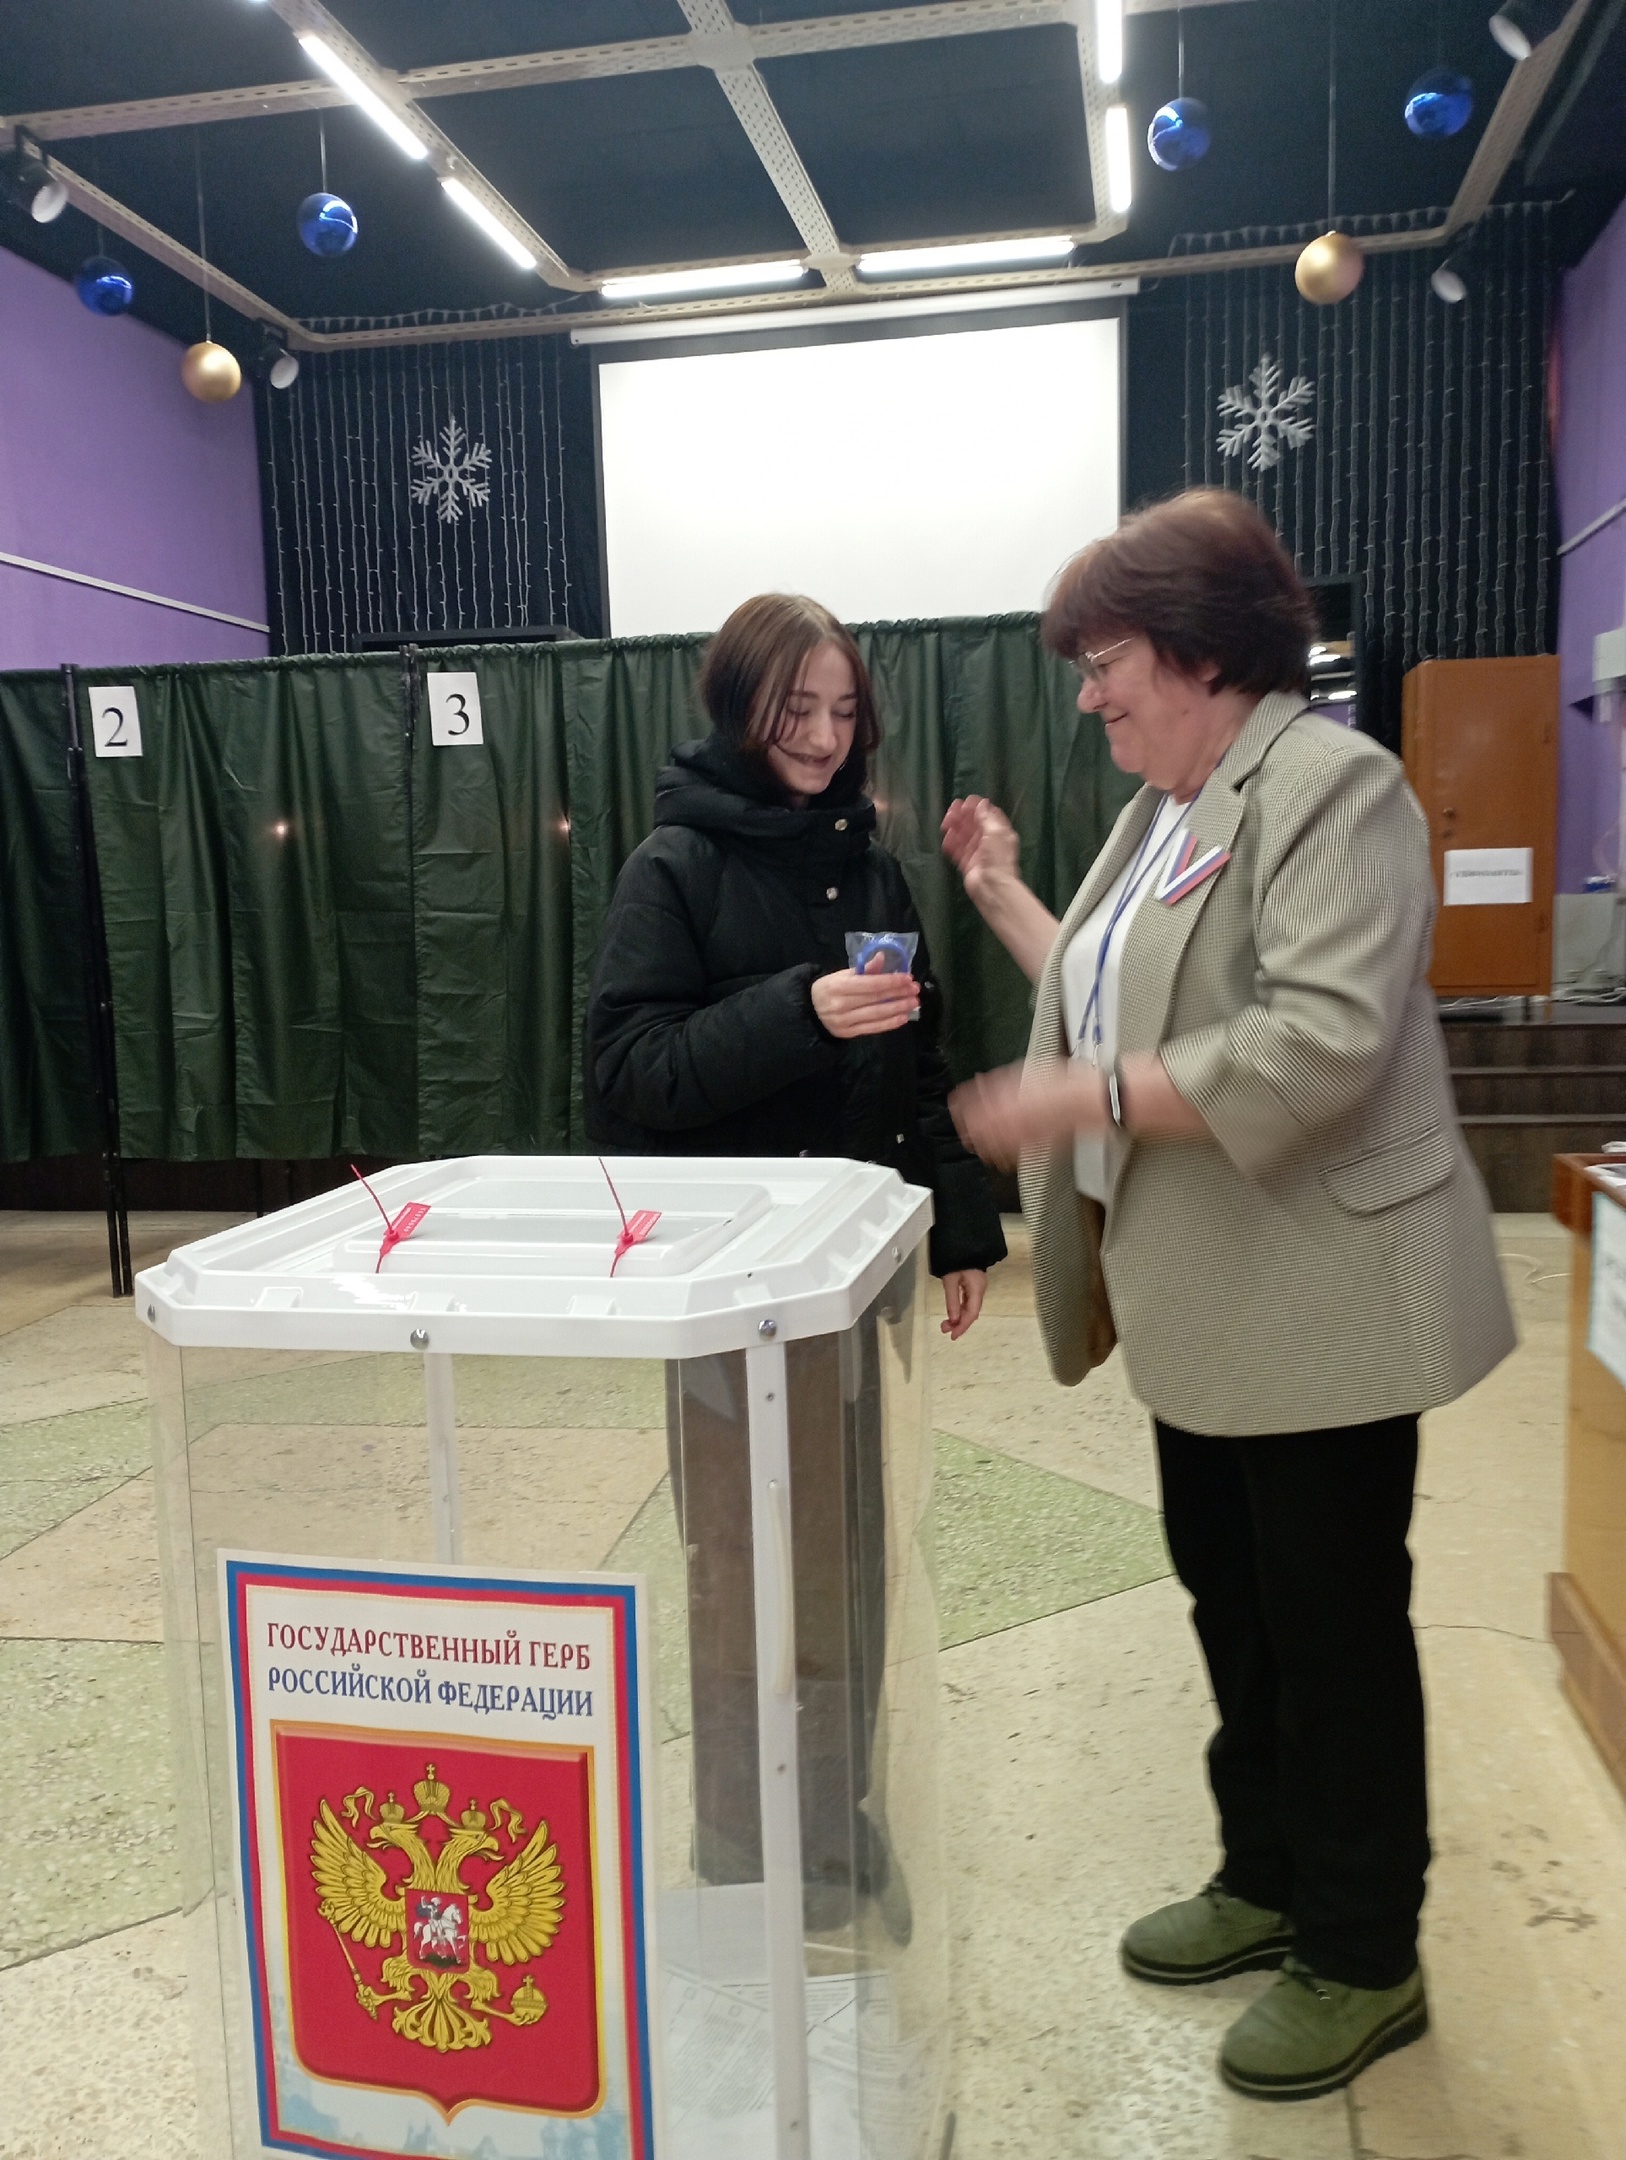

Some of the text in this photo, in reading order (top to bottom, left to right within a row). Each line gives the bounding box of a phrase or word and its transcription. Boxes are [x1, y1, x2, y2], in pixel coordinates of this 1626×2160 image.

[102, 707, 128, 747] 2
[447, 693, 470, 736] 3
[267, 1622, 591, 1670] ГОСУДАРСТВЕННЫЙ ГЕРБ
[268, 1662, 593, 1721] РОССИЙСКОЙ ФЕДЕРАЦИИ
